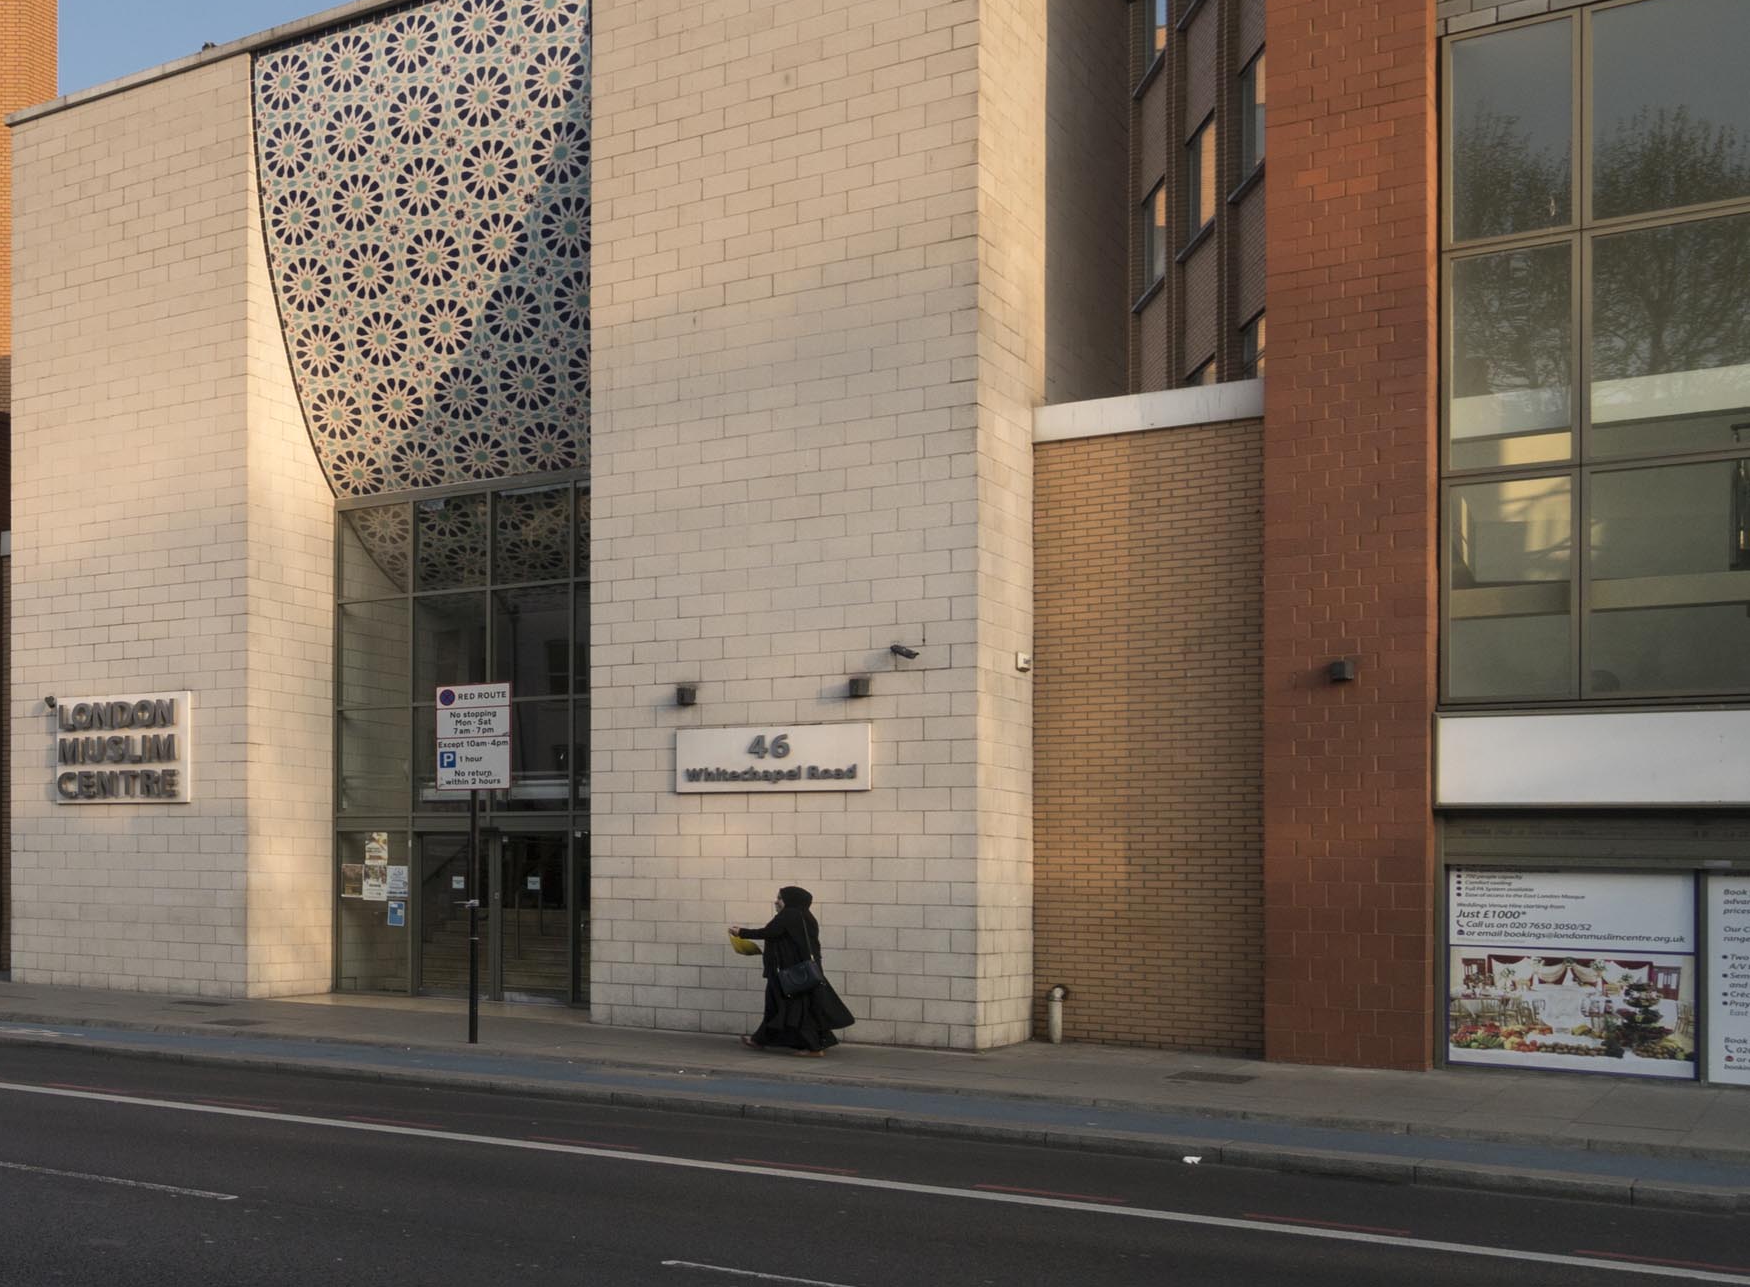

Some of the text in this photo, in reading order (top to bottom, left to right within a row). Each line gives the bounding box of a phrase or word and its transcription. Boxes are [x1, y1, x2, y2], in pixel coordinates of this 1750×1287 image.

[458, 691, 507, 700] RED ROUTE
[58, 698, 176, 731] LONDON
[463, 710, 497, 718] stopping
[477, 718, 492, 726] Sat
[58, 734, 179, 764] MUSLIM
[747, 734, 790, 759] 46
[443, 753, 454, 767] P
[685, 764, 857, 783] Whitechapel Road
[57, 769, 179, 798] CENTRE
[1456, 910, 1480, 918] Just
[1529, 922, 1552, 930] 7650
[1477, 930, 1503, 938] email
